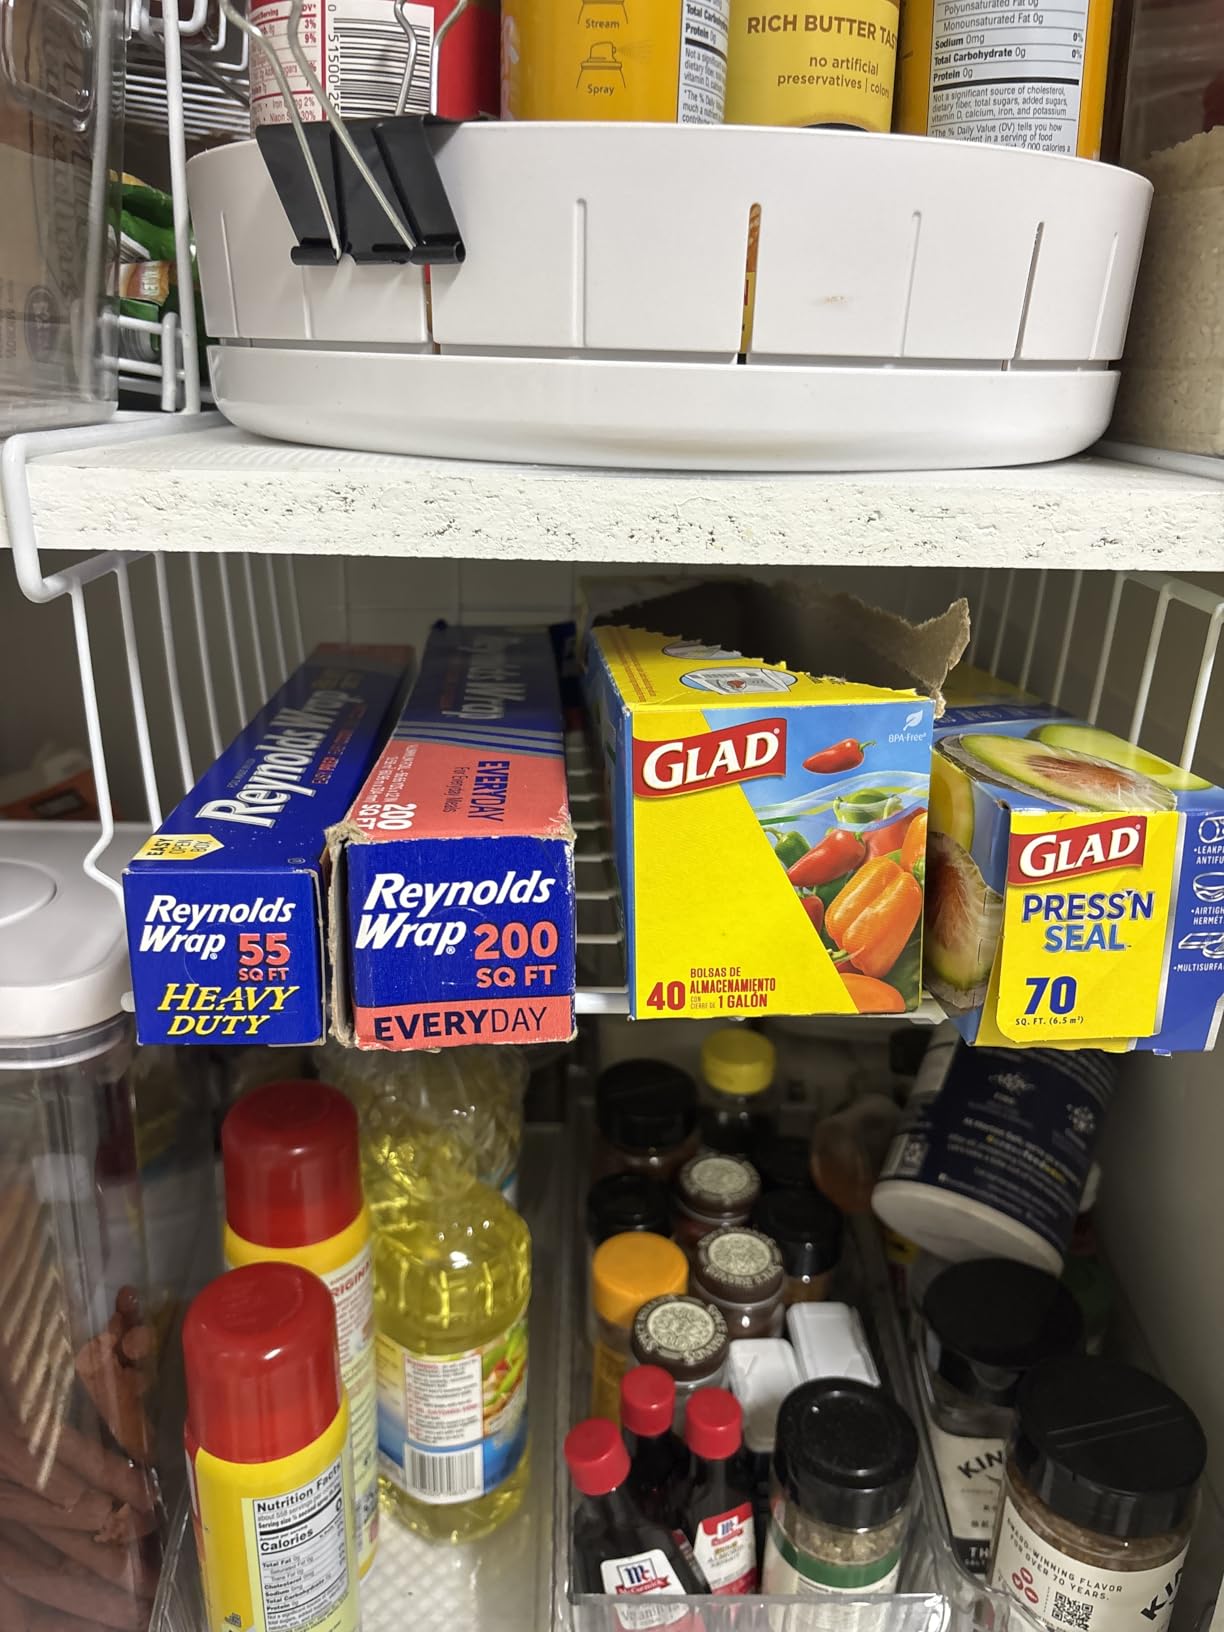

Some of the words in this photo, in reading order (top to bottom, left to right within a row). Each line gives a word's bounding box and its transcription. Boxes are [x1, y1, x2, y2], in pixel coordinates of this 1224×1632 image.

[686, 4, 702, 18] Total
[304, 20, 317, 29] 3%
[585, 19, 619, 29] Stream
[685, 23, 709, 39] Protein
[747, 14, 798, 34] RICH
[804, 14, 876, 40] BUTTER
[944, 13, 1014, 32] Monounsaturated
[1018, 13, 1030, 23] Fat
[1033, 13, 1043, 24] 0g
[304, 35, 317, 44] 9%
[935, 36, 963, 50] Sodium
[966, 34, 985, 45] 0mg
[328, 35, 340, 84] 51500
[935, 54, 951, 67] Total
[953, 48, 1012, 63] Carbohydrate
[1015, 46, 1026, 58] 0g
[809, 56, 828, 68] no
[832, 57, 879, 76] artificial
[777, 74, 863, 89] preservatives
[933, 70, 960, 84] Protein
[962, 67, 973, 78] 0g
[586, 83, 615, 96] Spray
[934, 94, 944, 103] Not
[951, 88, 988, 100] significant
[990, 87, 1016, 95] source
[1018, 86, 1026, 95] of
[304, 97, 316, 106] 2%
[932, 101, 954, 114] dietary
[974, 99, 991, 107] total
[993, 97, 1020, 108] sugars,
[1022, 96, 1044, 105] added
[966, 109, 996, 119] calcium,
[998, 108, 1015, 117] iron,
[1017, 107, 1031, 115] and
[1033, 107, 1067, 118] potassium
[957, 125, 974, 136] Daily
[976, 124, 996, 133] Value
[999, 122, 1016, 133] (DV)
[1017, 123, 1033, 131] tells
[1035, 124, 1047, 134] you
[1049, 123, 1063, 131] how
[1000, 134, 1028, 144] serving
[1029, 132, 1037, 142] of
[1038, 133, 1053, 142] food
[1042, 144, 1067, 153] calories
[195, 729, 328, 829] Reynolds
[268, 690, 365, 731] Wrap
[643, 731, 780, 790] GLAD
[444, 776, 468, 795] Everyday
[468, 760, 510, 822] EVERYDAY
[358, 803, 379, 817] SQ
[376, 802, 417, 830] 200
[356, 817, 376, 831] FT
[147, 838, 170, 857] EASY
[169, 838, 193, 855] OPEN
[191, 839, 212, 856] BOX
[1019, 826, 1140, 878] GLAD
[363, 870, 556, 918] Reynolds
[145, 895, 297, 930] Reynolds
[474, 921, 558, 960] 200
[1042, 923, 1126, 952] SEAL
[239, 933, 291, 966] 55
[239, 968, 265, 981] SQ
[268, 968, 290, 981] FT
[476, 967, 517, 988] SQ
[525, 965, 558, 985] FT
[690, 967, 726, 978] BOLSAS
[729, 966, 741, 977] DE
[690, 977, 776, 994] ALMACENAMIENTO
[147, 983, 299, 1013] HEAVY
[646, 981, 686, 1011] 40
[718, 995, 723, 1008] 1
[727, 991, 767, 1008] GALÓN
[1024, 976, 1077, 1015] 70
[157, 1014, 270, 1036] DUTY
[374, 1006, 548, 1042] EVERYDAY
[1015, 1018, 1031, 1026] SQ.
[1034, 1017, 1047, 1025] FT.
[1049, 1017, 1067, 1025] (6.5
[258, 1488, 314, 1513] Nutrition
[336, 1497, 342, 1512] 0
[259, 1519, 280, 1529] Serving
[261, 1529, 313, 1551] Calories
[263, 1560, 279, 1568] Total
[281, 1557, 292, 1565] Fat
[1010, 1533, 1023, 1554] FOR
[1025, 1553, 1049, 1577] OVER
[1052, 1575, 1066, 1586] 70
[1070, 1582, 1111, 1601] YEARS.
[264, 1577, 302, 1590] Cholesterol
[1079, 1577, 1123, 1593] FLAVOR
[266, 1589, 290, 1597] Sodium
[267, 1603, 290, 1611] Protein
